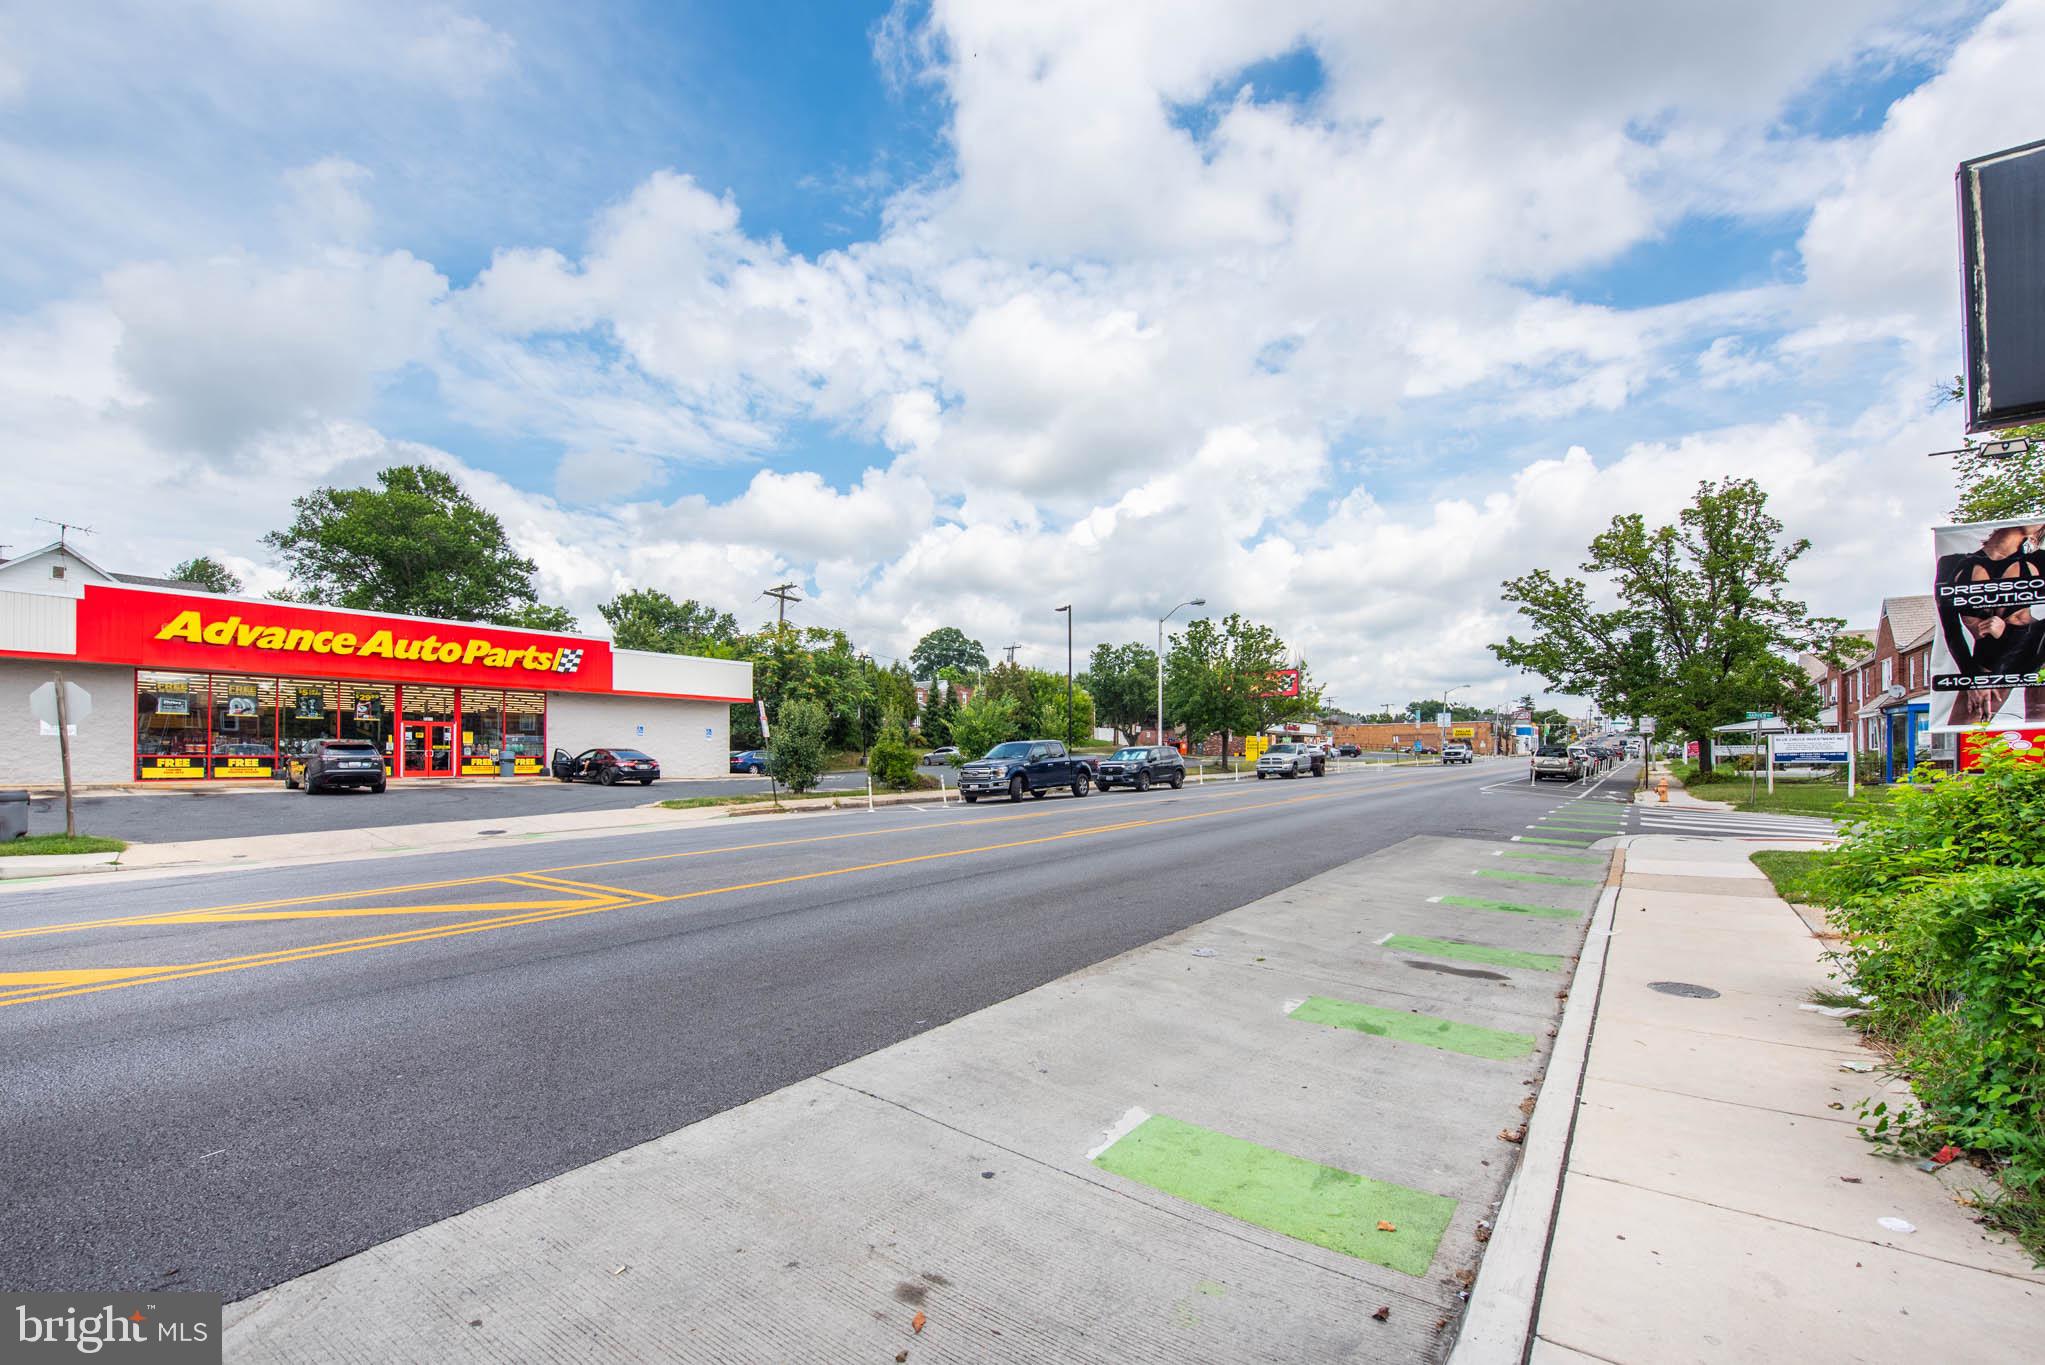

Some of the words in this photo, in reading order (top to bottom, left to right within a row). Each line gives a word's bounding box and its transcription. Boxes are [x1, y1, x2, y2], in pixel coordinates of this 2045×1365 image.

[155, 610, 358, 655] Advance
[356, 630, 463, 663] Auto
[461, 640, 552, 671] Parts
[1937, 673, 2045, 687] 410.575.3
[157, 683, 188, 691] FREE
[157, 758, 190, 767] FREE
[228, 758, 259, 767] FREE
[471, 758, 493, 766] FREE
